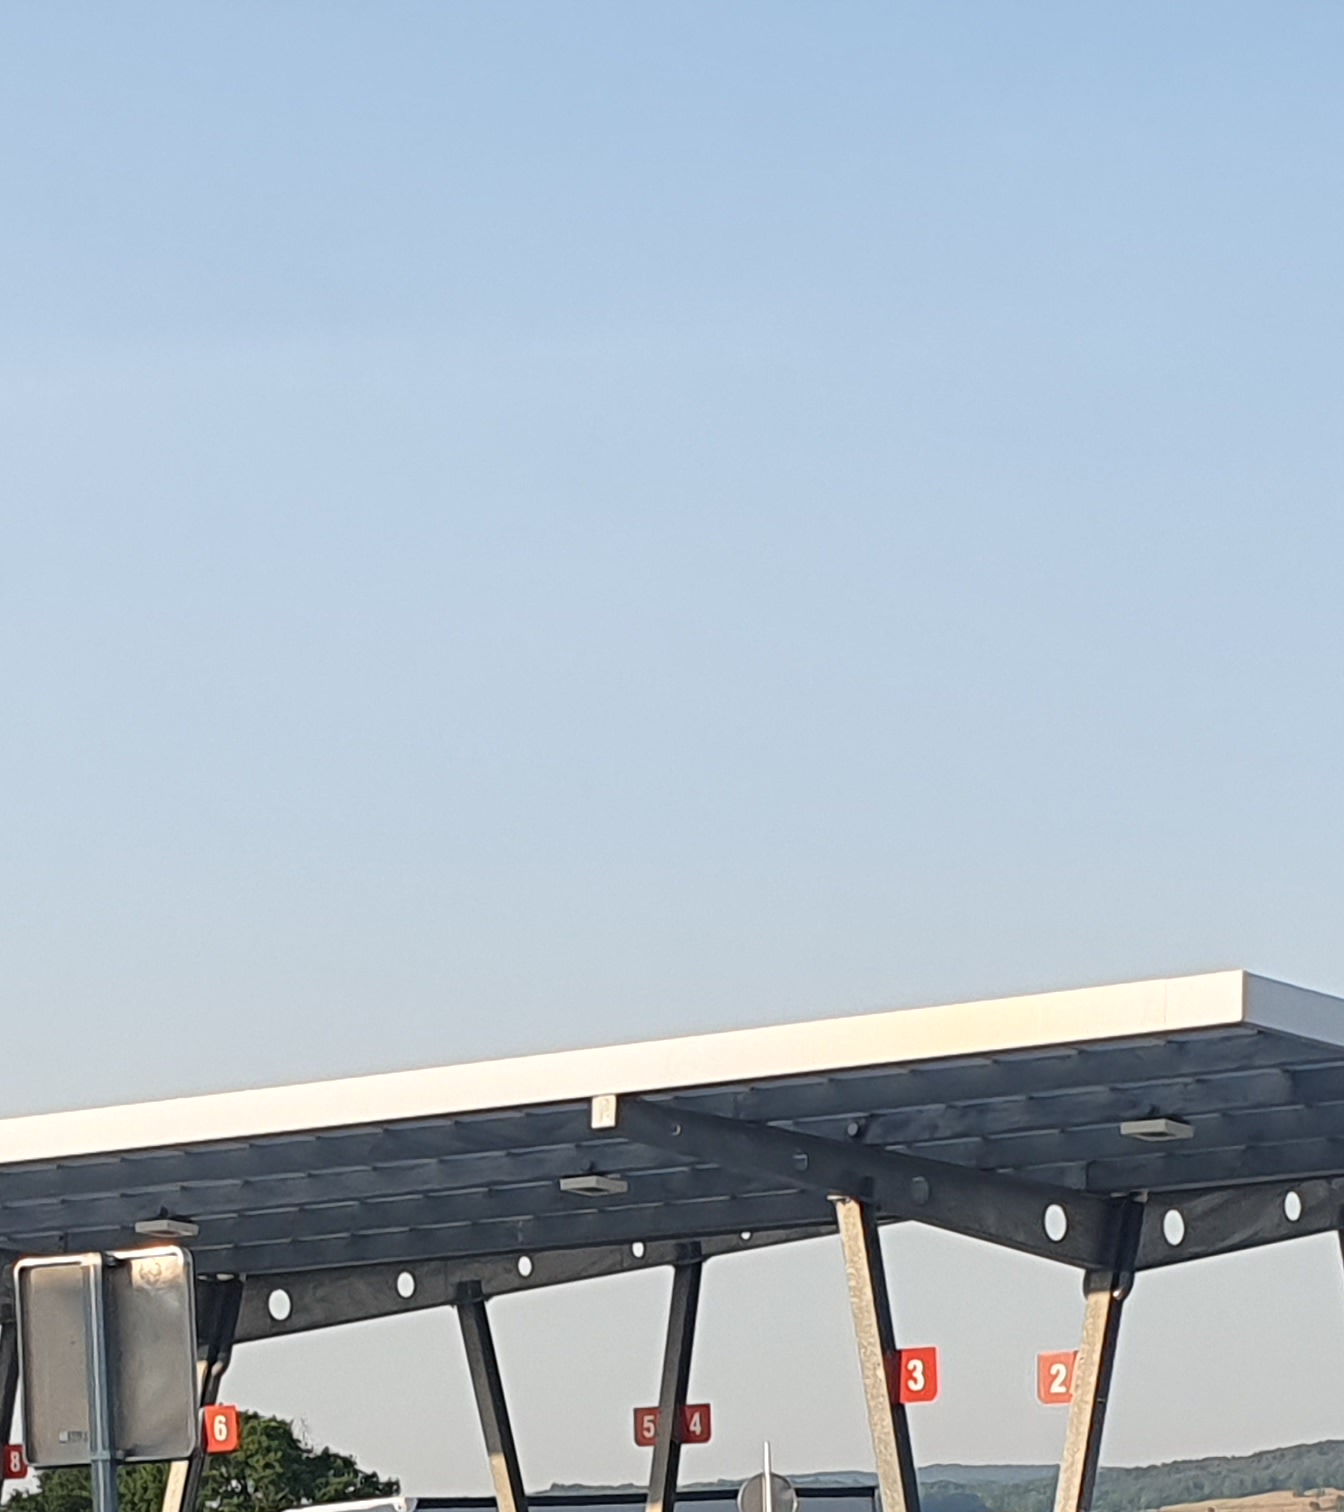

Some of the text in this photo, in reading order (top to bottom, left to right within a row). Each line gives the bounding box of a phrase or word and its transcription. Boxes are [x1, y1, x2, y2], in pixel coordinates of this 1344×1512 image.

[907, 1359, 926, 1391] 3
[1049, 1363, 1068, 1394] 2
[214, 1415, 227, 1441] 6
[642, 1415, 655, 1438] 5
[689, 1411, 702, 1436] 4
[10, 1451, 20, 1473] 8
